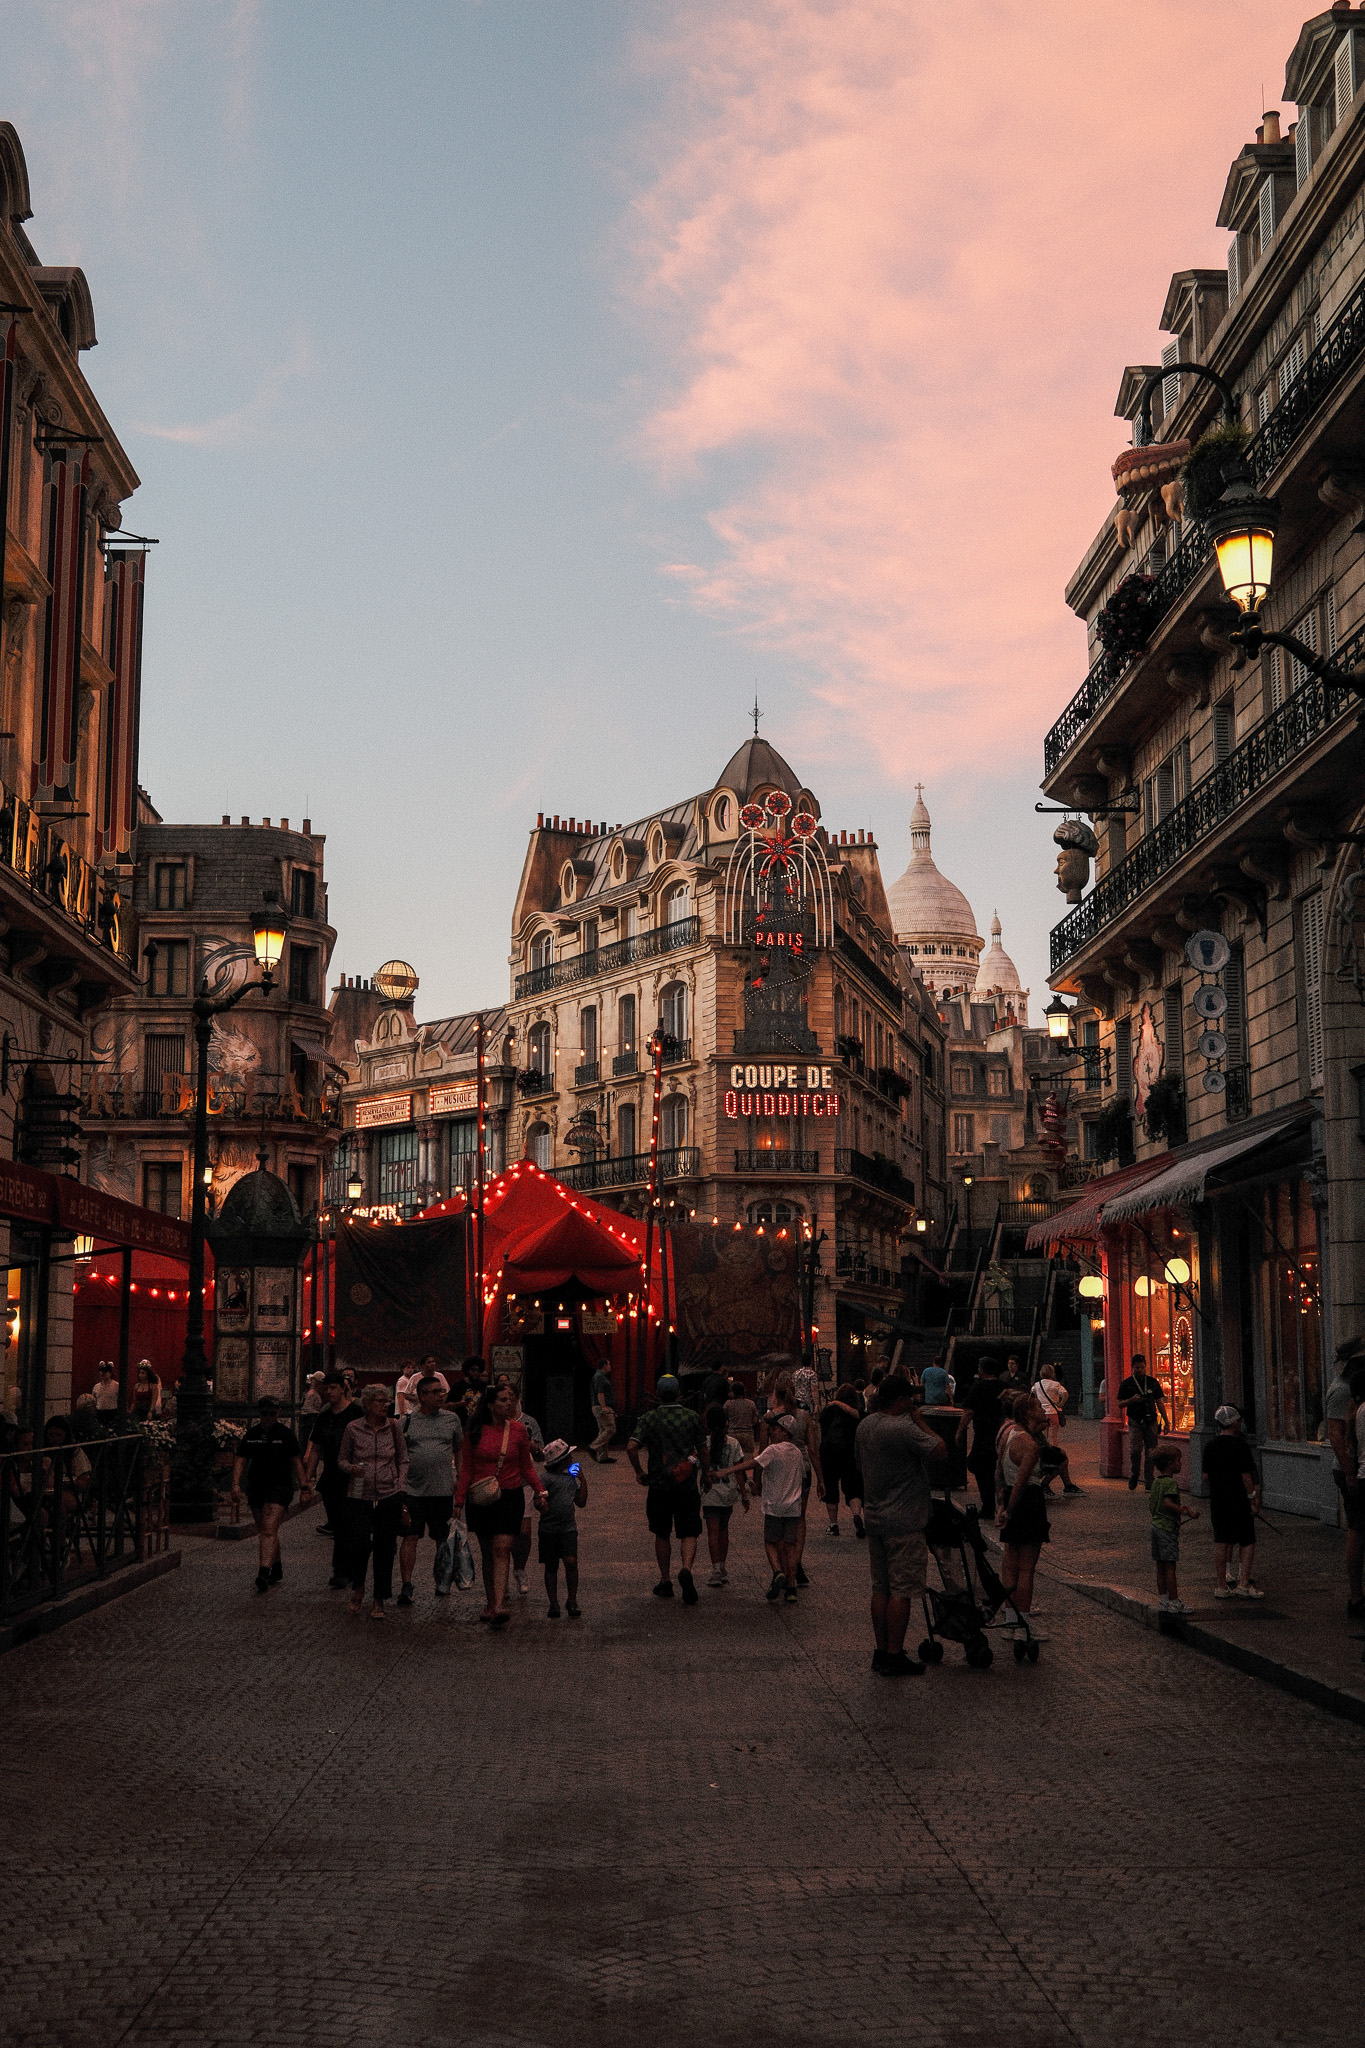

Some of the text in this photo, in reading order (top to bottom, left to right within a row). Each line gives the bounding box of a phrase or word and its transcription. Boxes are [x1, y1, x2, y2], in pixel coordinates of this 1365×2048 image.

[756, 931, 804, 947] PARIS
[731, 1065, 833, 1089] COUPE DE
[443, 1092, 472, 1106] MUSIQUE
[724, 1090, 840, 1119] QUIDDITCH
